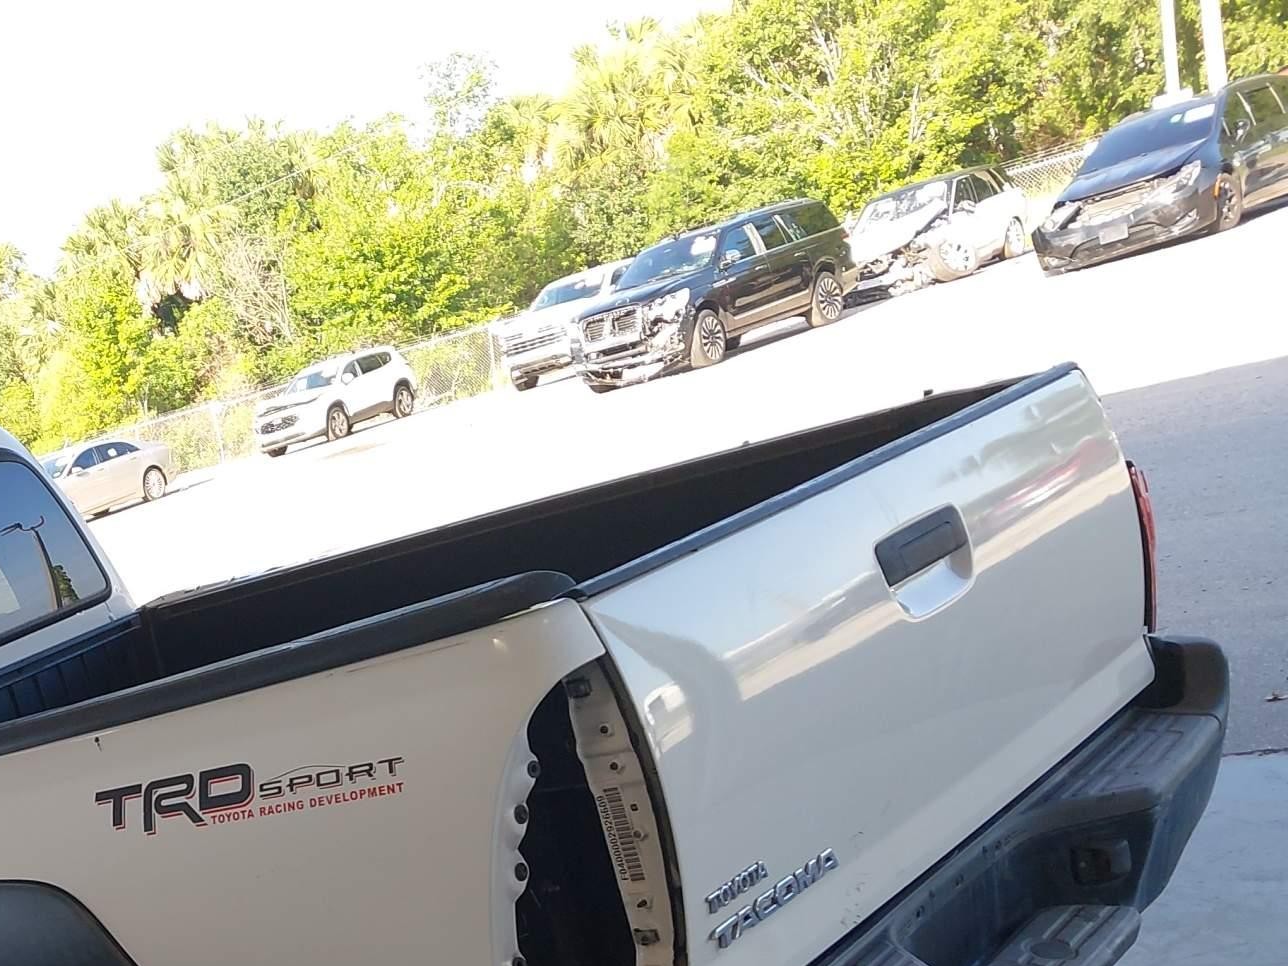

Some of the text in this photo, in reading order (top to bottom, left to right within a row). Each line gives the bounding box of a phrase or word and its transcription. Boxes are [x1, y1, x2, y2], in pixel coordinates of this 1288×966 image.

[95, 757, 405, 835] TRD SPORT
[211, 782, 404, 825] TOYOTA RACING DEVELOPMENT
[705, 860, 769, 914] TOYOTA
[712, 847, 841, 949] TACOMA
